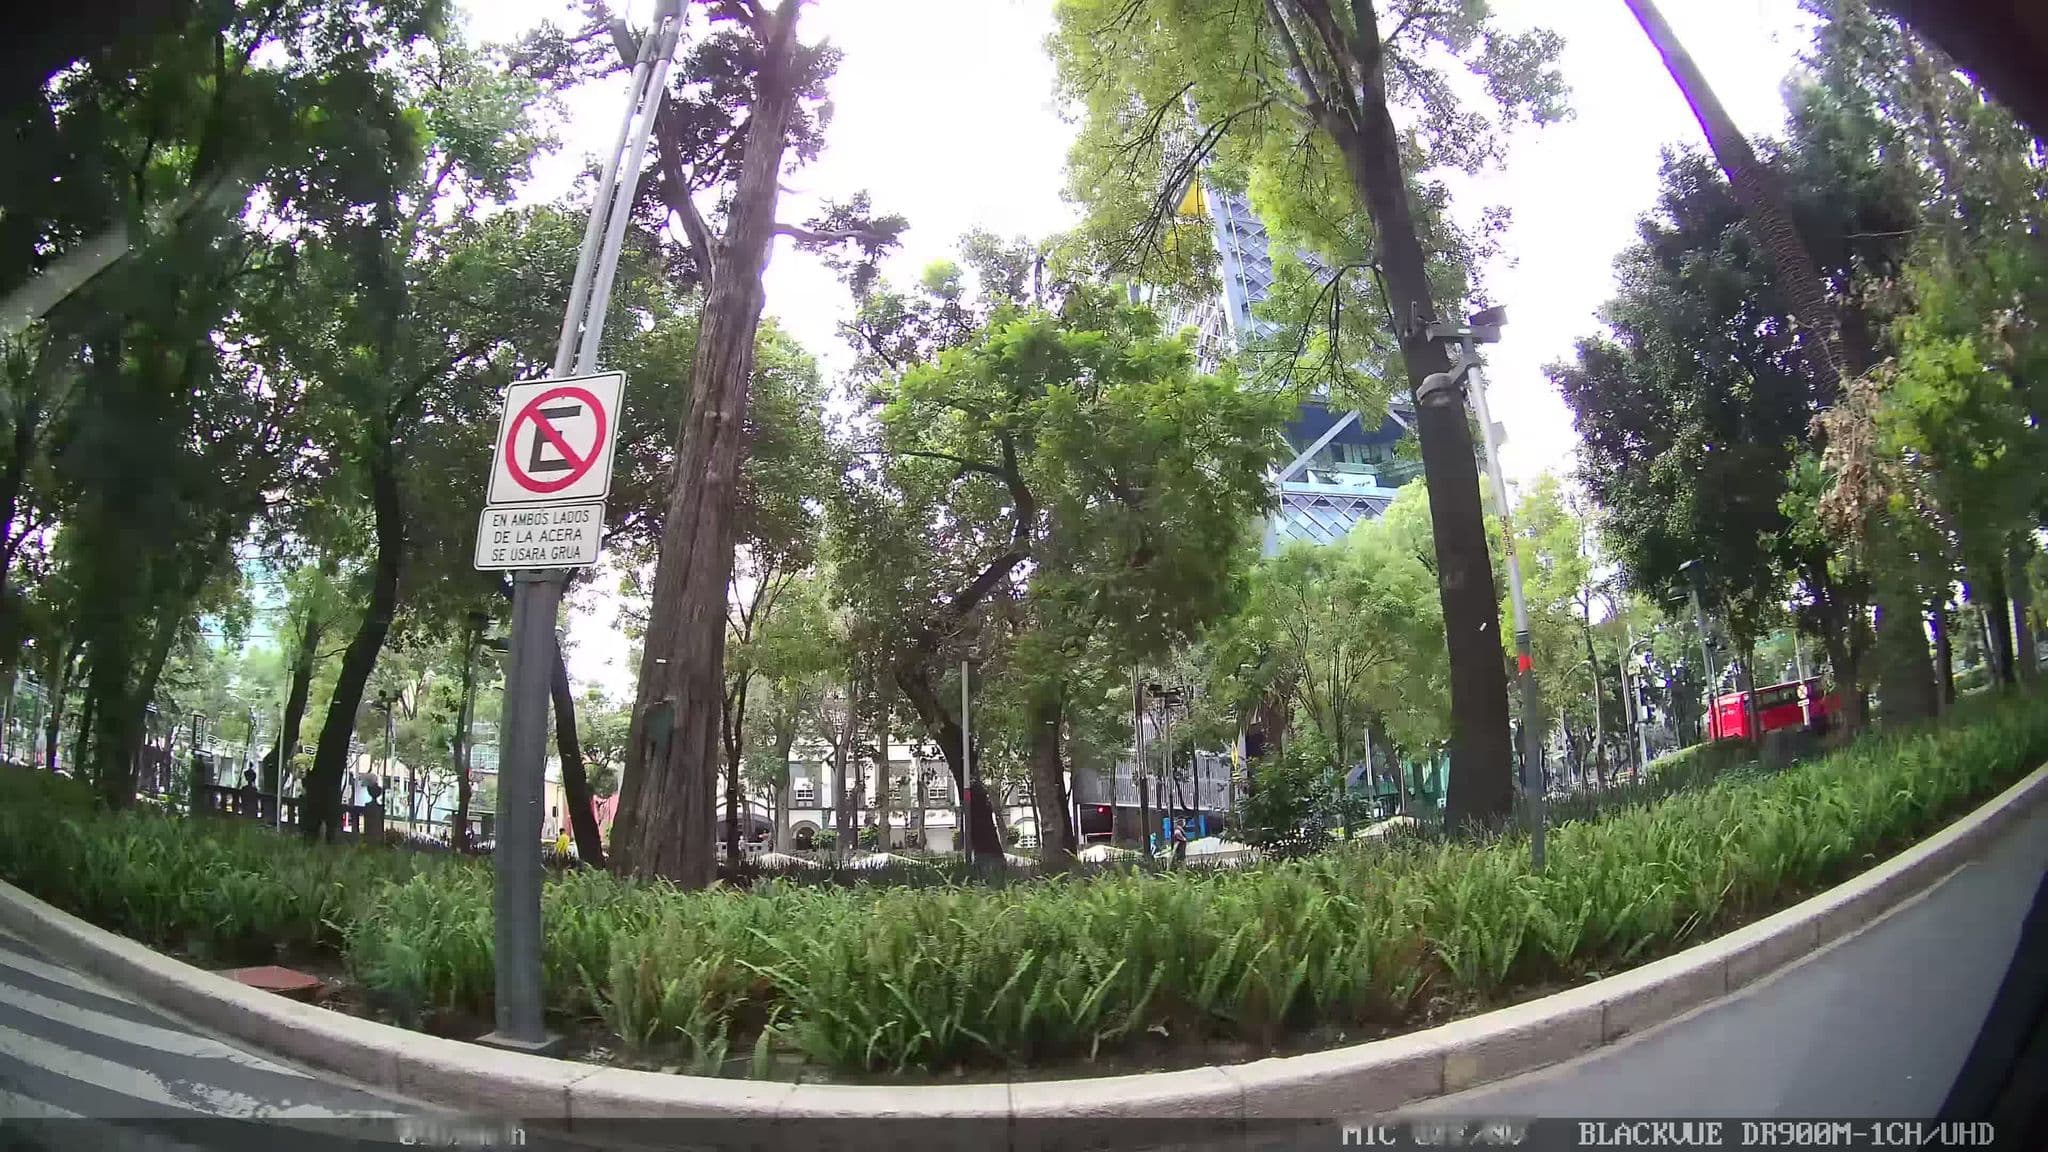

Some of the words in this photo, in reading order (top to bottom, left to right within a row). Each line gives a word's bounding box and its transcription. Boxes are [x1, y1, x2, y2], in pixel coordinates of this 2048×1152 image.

[493, 514, 507, 527] EN
[511, 512, 549, 526] AMBOS
[553, 510, 589, 524] LADOS
[493, 531, 511, 544] DE
[516, 530, 533, 543] LA
[538, 528, 582, 542] ACERA
[492, 548, 506, 561] SE
[511, 547, 546, 561] USARA
[551, 545, 580, 560] GRUA
